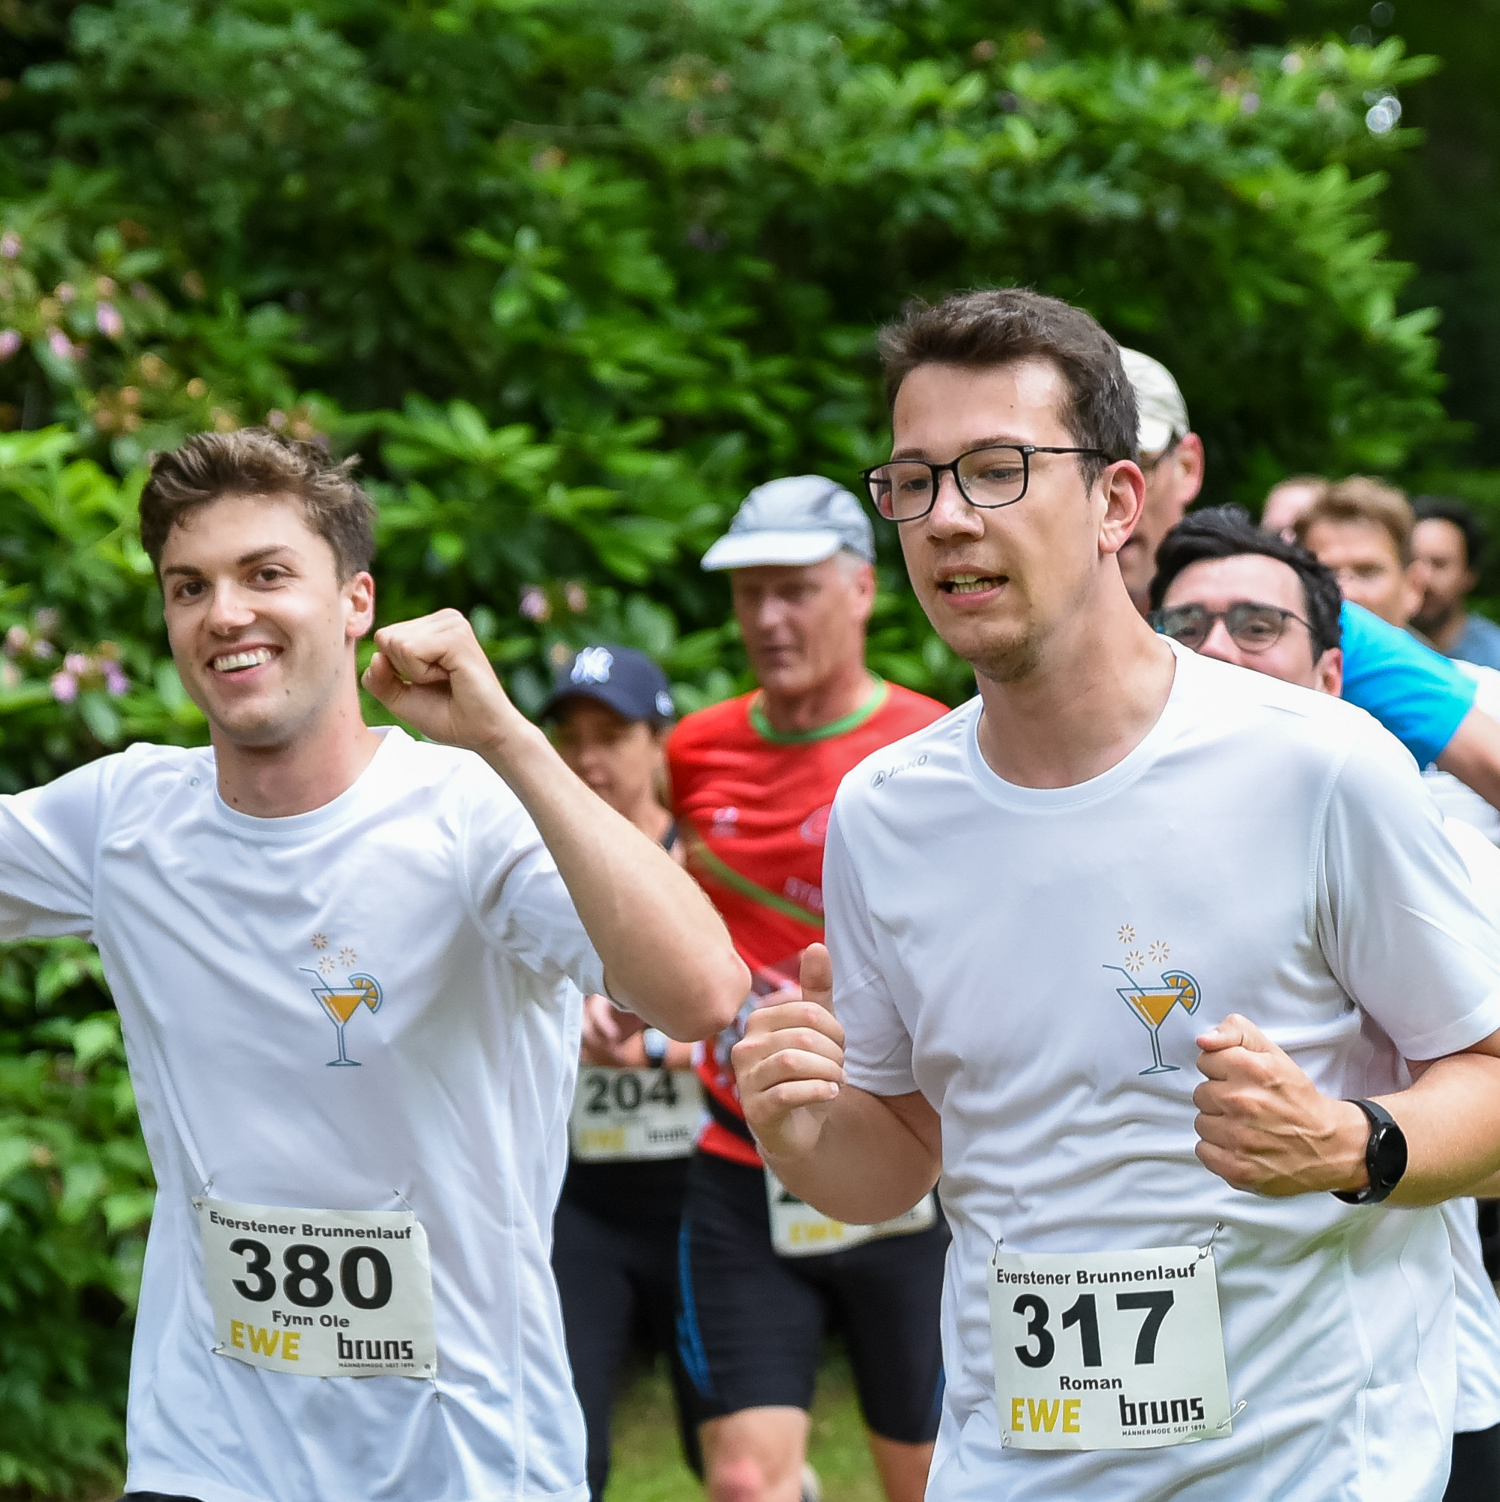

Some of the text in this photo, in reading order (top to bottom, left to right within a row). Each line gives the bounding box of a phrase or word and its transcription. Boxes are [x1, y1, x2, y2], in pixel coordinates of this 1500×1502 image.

[585, 1068, 678, 1113] 204
[209, 1210, 412, 1240] Everstener Brunnenlauf
[228, 1237, 394, 1311] 380
[996, 1263, 1196, 1285] Everstener Brunnenlauf
[271, 1310, 350, 1328] Fynn Ole
[1012, 1289, 1175, 1369] 317
[230, 1318, 301, 1362] EWE
[336, 1331, 414, 1361] bruns
[1059, 1375, 1123, 1391] Roman
[1010, 1397, 1082, 1433] EWE
[1118, 1394, 1205, 1427] bruns
[1173, 1425, 1189, 1433] SEIT
